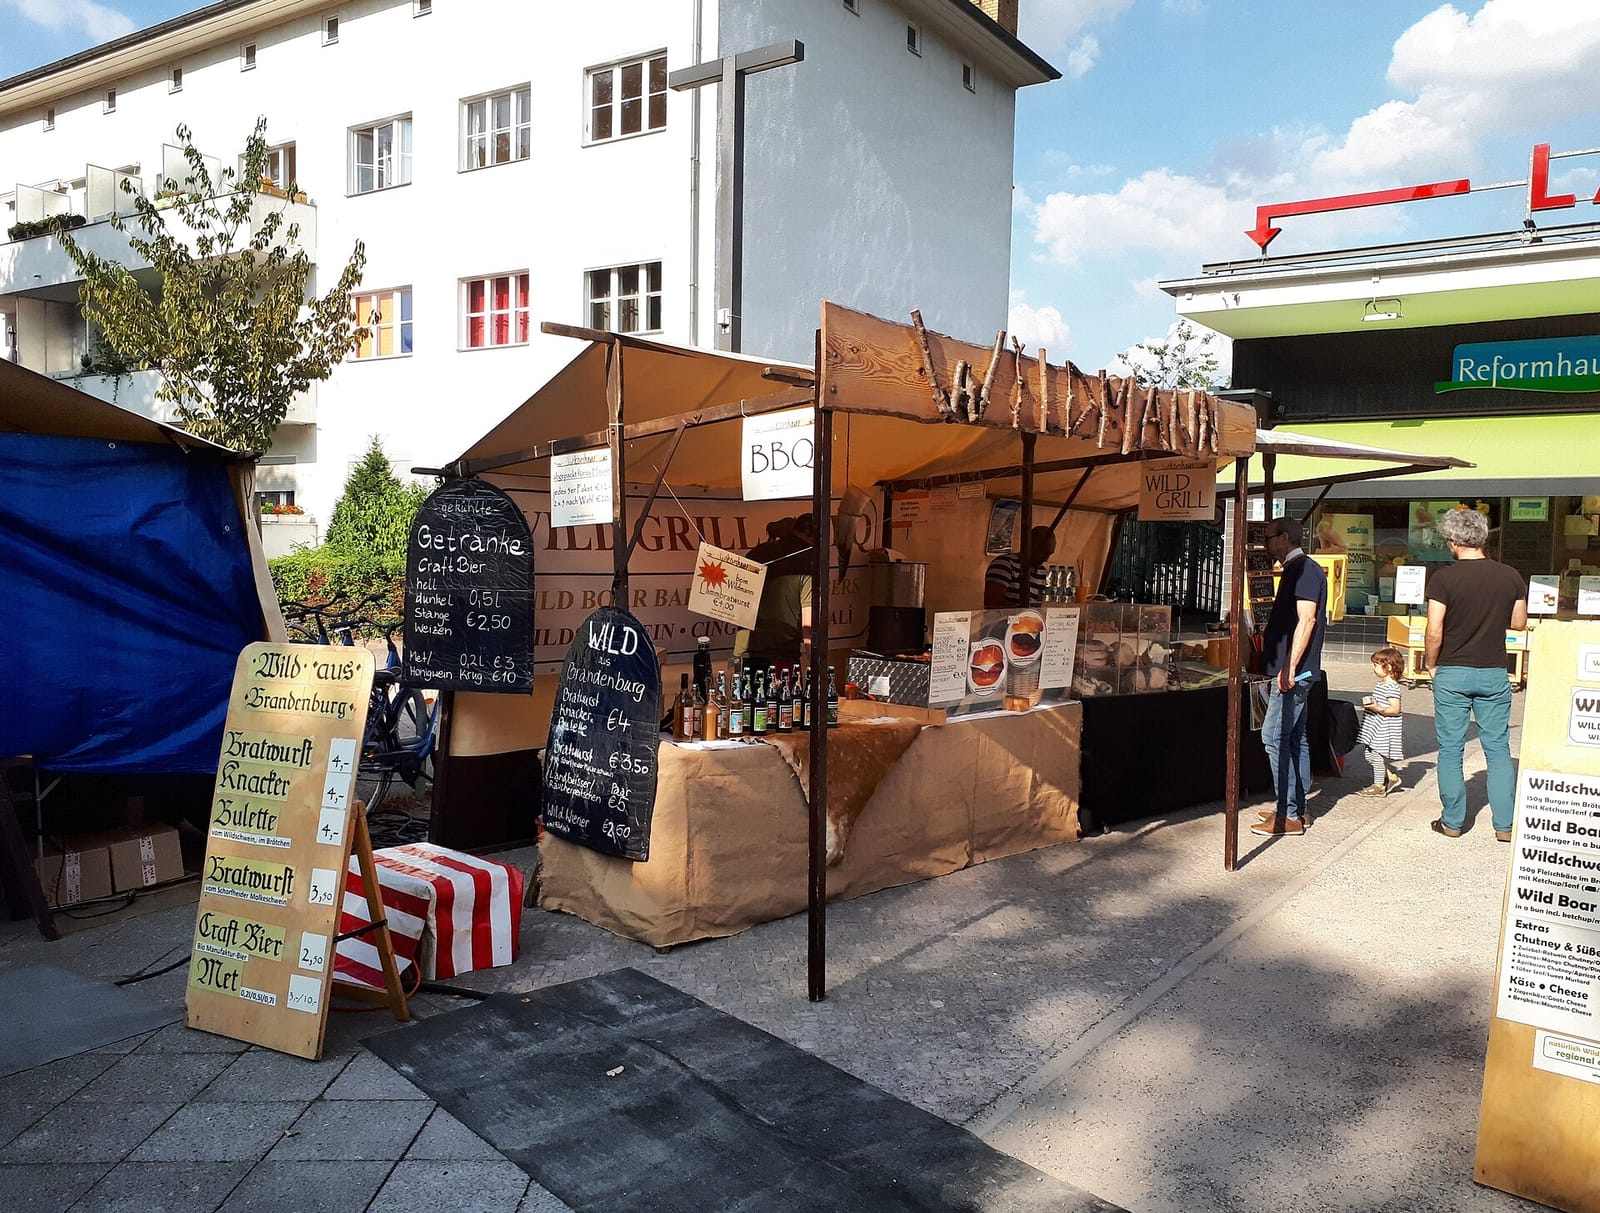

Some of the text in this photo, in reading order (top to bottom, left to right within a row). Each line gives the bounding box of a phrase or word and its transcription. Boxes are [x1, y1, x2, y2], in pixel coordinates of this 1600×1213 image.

[751, 438, 815, 474] BBQ
[1145, 474, 1190, 492] WILD
[1155, 490, 1209, 509] GRILL
[417, 524, 525, 556] Getränke
[637, 515, 761, 552] GRILL
[418, 556, 486, 576] Craft Bier
[416, 578, 437, 591] hell
[727, 579, 754, 596] Wildmann
[415, 592, 454, 606] dunkel
[414, 608, 511, 631] Stange €2,50
[414, 622, 453, 636] Weizen
[588, 620, 638, 655] WILD
[254, 652, 354, 681] Wild aus
[409, 665, 517, 685] Honigwein Krug €10
[567, 661, 646, 703] Brandenburg
[246, 686, 348, 719] Brandenburg
[607, 708, 632, 732] €4
[224, 731, 350, 772] Bratwurst 4,-
[218, 760, 345, 804] Knacker 4,-
[547, 802, 564, 819] Wild
[1539, 805, 1587, 816] Ketchup/Senf
[1544, 797, 1569, 806] Burger
[213, 798, 339, 841] Bulette 4,-
[1525, 817, 1561, 833] Wild
[211, 829, 223, 837] vom
[223, 830, 257, 844] Wildschwein,
[266, 837, 290, 847] Brötchen
[1523, 833, 1542, 841] 150g
[1543, 835, 1571, 845] burger
[206, 855, 295, 896] Bratwurst
[1519, 866, 1535, 874] 150g
[205, 885, 216, 893] vom
[1532, 876, 1580, 890] Ketchup/Senf
[311, 884, 333, 903] 3,50
[1517, 887, 1598, 912] Wild Boar
[1530, 906, 1544, 914] bun
[1546, 908, 1561, 917] incl.
[198, 911, 284, 957] Craft Bier
[1515, 919, 1550, 934] Extras
[1514, 933, 1561, 951] Chutney
[1563, 942, 1573, 952] &
[197, 943, 323, 967] Bio Manufaktur-Bier 2,50
[197, 957, 239, 992] Met
[1565, 975, 1590, 986] Mustard
[1509, 975, 1589, 1000] Käse Cheese
[1566, 999, 1587, 1009] Cheese
[1571, 1007, 1592, 1017] Cheese
[1548, 1040, 1582, 1053] natürlich
[1556, 1050, 1595, 1066] regional
